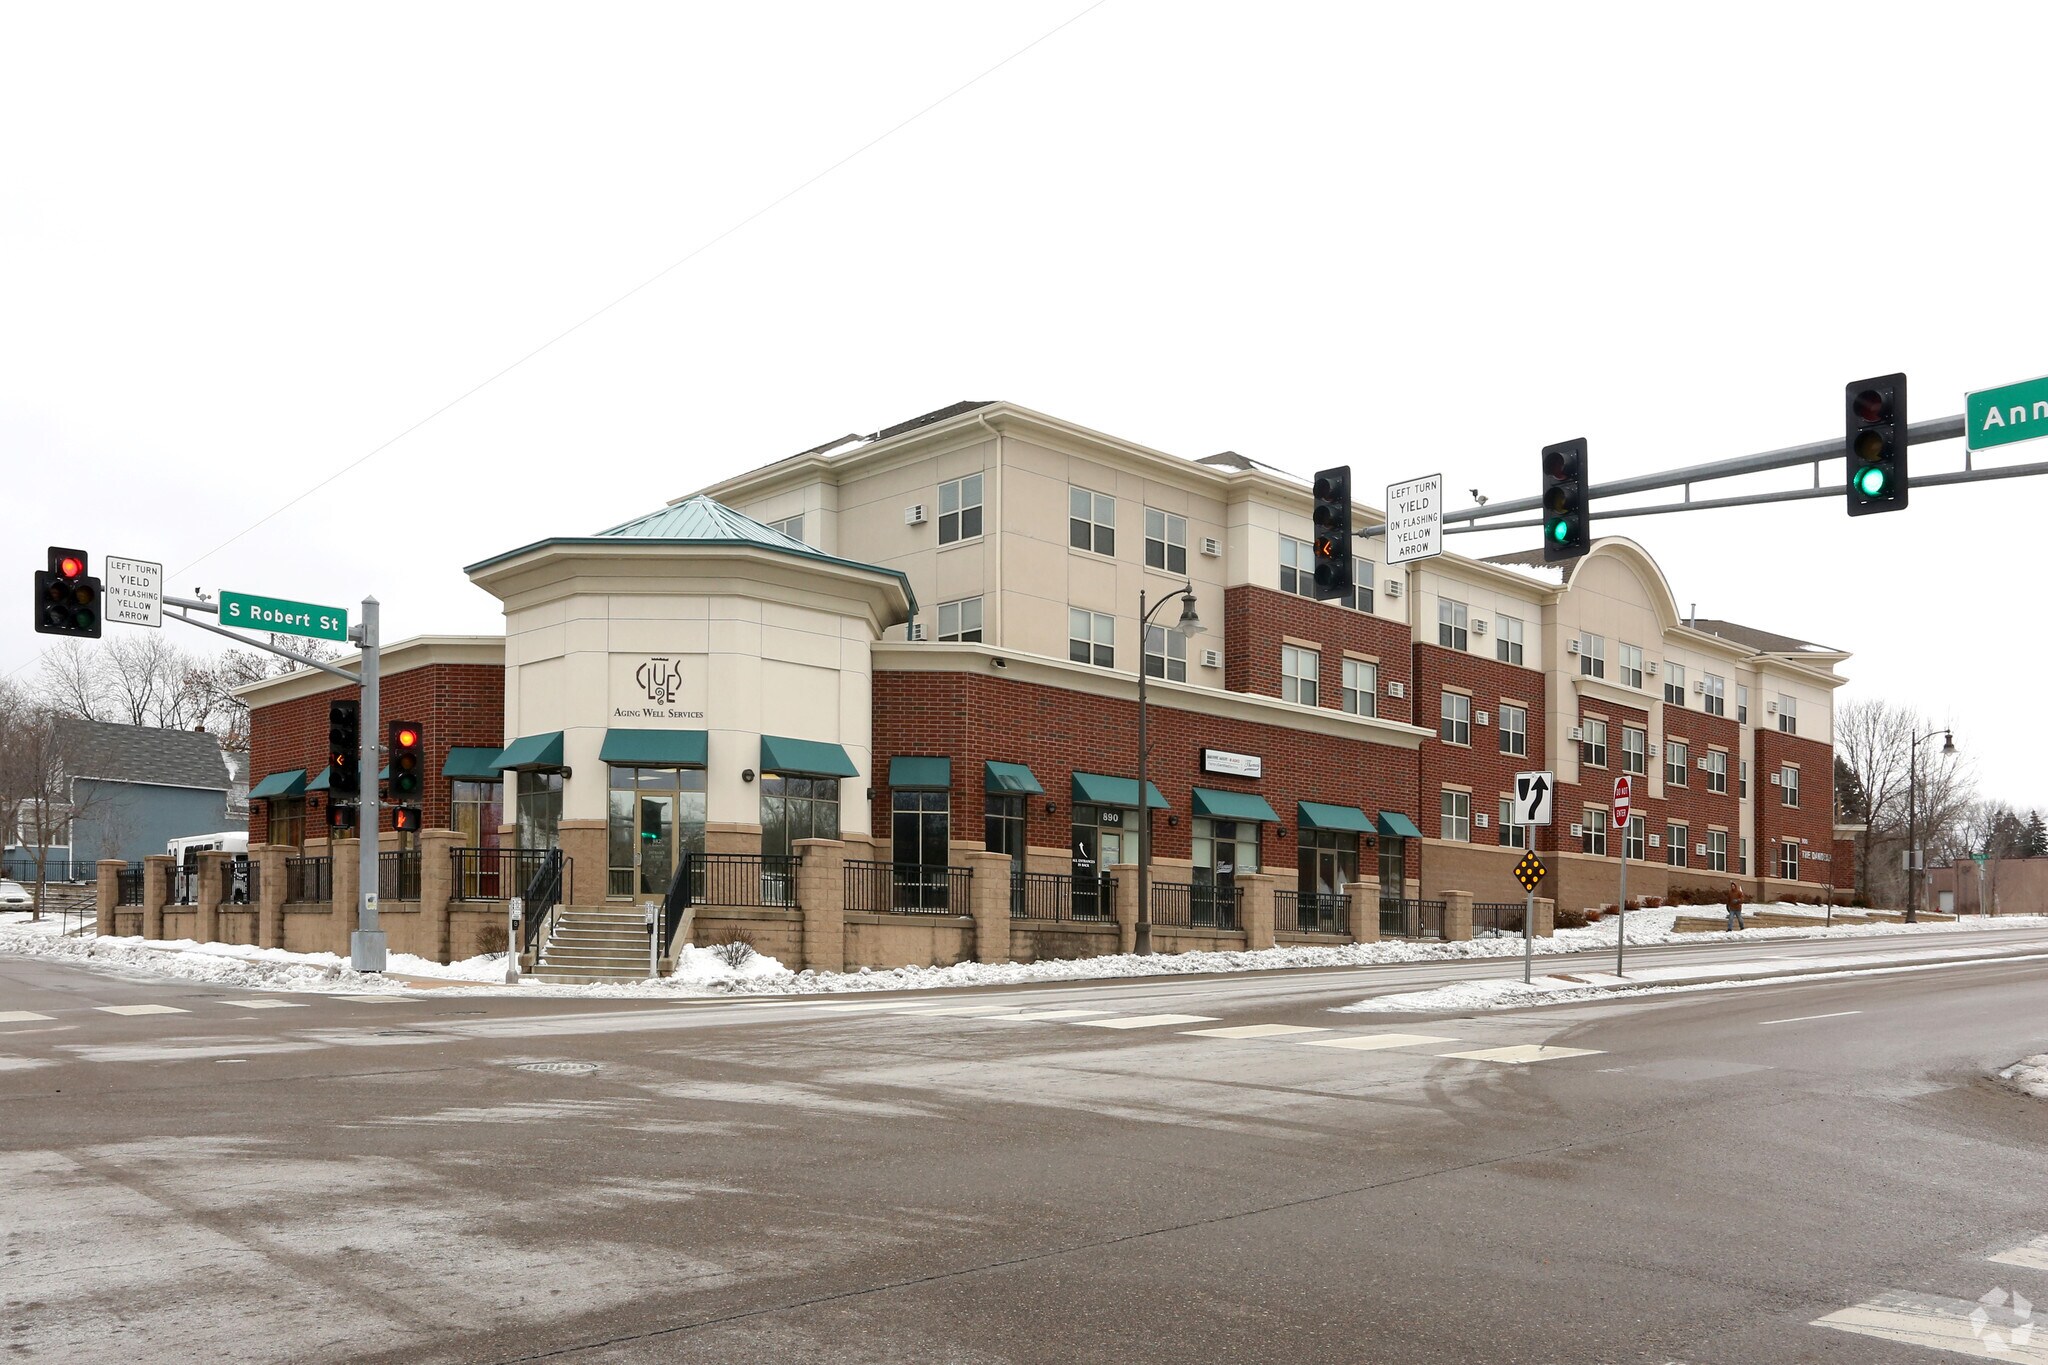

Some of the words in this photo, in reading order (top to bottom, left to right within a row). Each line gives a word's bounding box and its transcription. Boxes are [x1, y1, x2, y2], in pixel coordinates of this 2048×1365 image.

[1983, 401, 2048, 430] Ann
[1391, 486, 1411, 499] LEFT
[1415, 481, 1437, 493] TURN
[1399, 497, 1429, 513] YIELD
[1390, 521, 1400, 530] ON
[1403, 512, 1438, 528] FLASHING
[1397, 528, 1431, 542] YELLOW
[1399, 542, 1429, 556] ARROW
[111, 561, 131, 571] LEFT
[136, 565, 157, 575] TURN
[119, 574, 150, 587] YIELD
[110, 586, 120, 594] ON
[123, 588, 158, 600] FLASHING
[117, 599, 151, 610] YELLOW
[119, 610, 149, 621] ARROW
[229, 602, 240, 616] S
[250, 605, 310, 627] Robert
[320, 615, 338, 631] St
[636, 660, 682, 703] CLUES
[1616, 788, 1621, 796] DO
[1103, 812, 1119, 822] 890
[1616, 809, 1626, 818] ENTER
